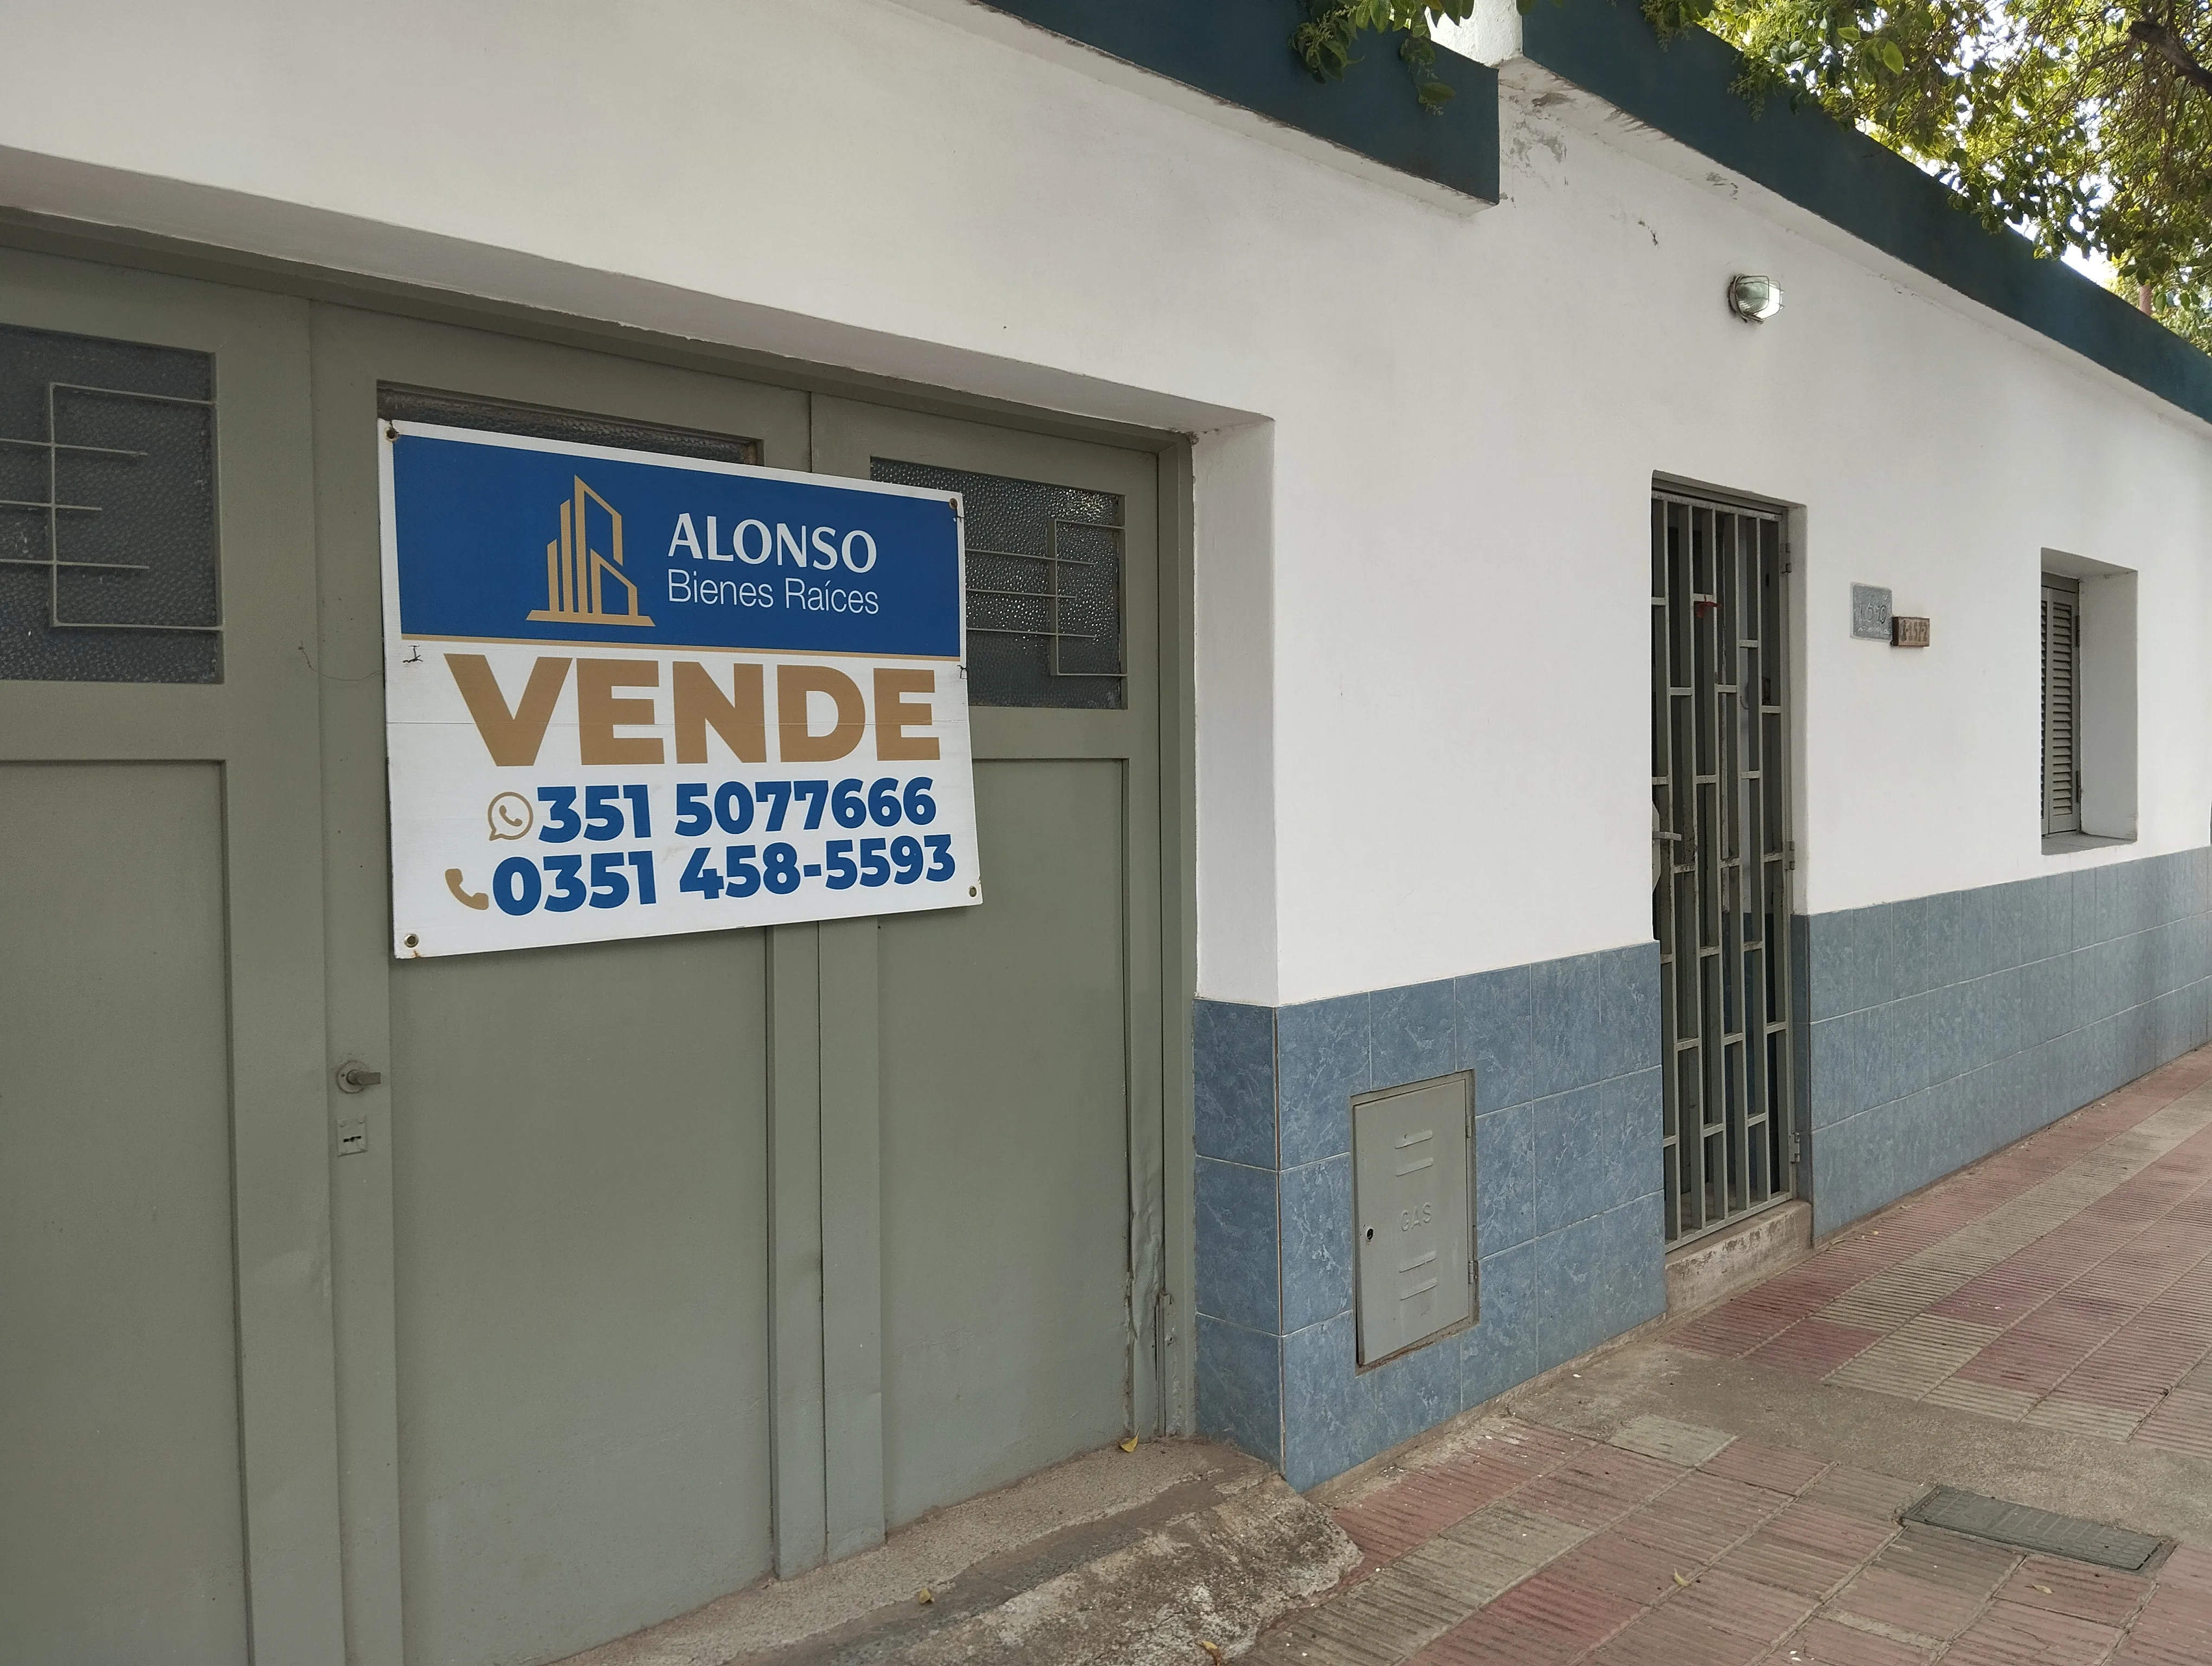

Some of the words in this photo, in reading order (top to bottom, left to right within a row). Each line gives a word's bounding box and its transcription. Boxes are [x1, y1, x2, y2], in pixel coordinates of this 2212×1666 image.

[668, 512, 877, 573] ALONSO
[668, 568, 774, 610] Bienes
[785, 578, 879, 614] Raíces
[445, 654, 941, 766] VENDE
[537, 784, 652, 843] 351
[675, 777, 937, 837] 5077666
[492, 850, 657, 916] 0351
[679, 834, 956, 900] 458-5593
[1400, 1202, 1432, 1232] GAS
